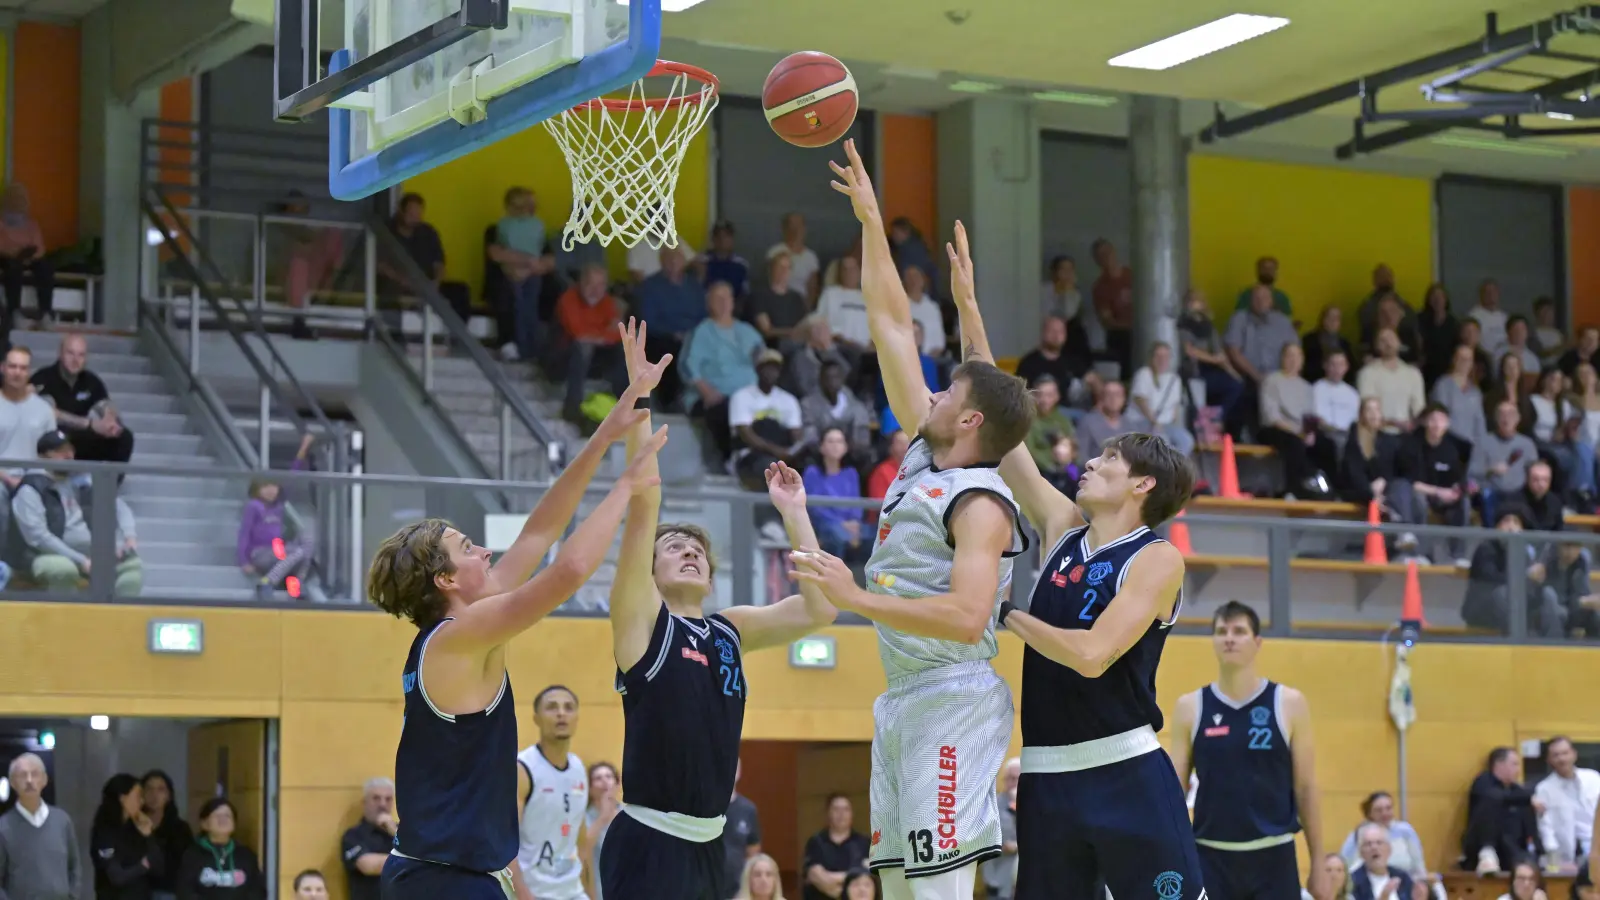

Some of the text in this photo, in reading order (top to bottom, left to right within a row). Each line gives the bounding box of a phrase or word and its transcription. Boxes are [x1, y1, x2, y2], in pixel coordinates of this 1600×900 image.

[1078, 588, 1098, 620] 2
[719, 664, 742, 699] 24
[1247, 727, 1273, 750] 22
[563, 792, 570, 813] 5
[536, 840, 554, 866] A
[908, 828, 934, 863] 13
[938, 850, 960, 862] JAKO
